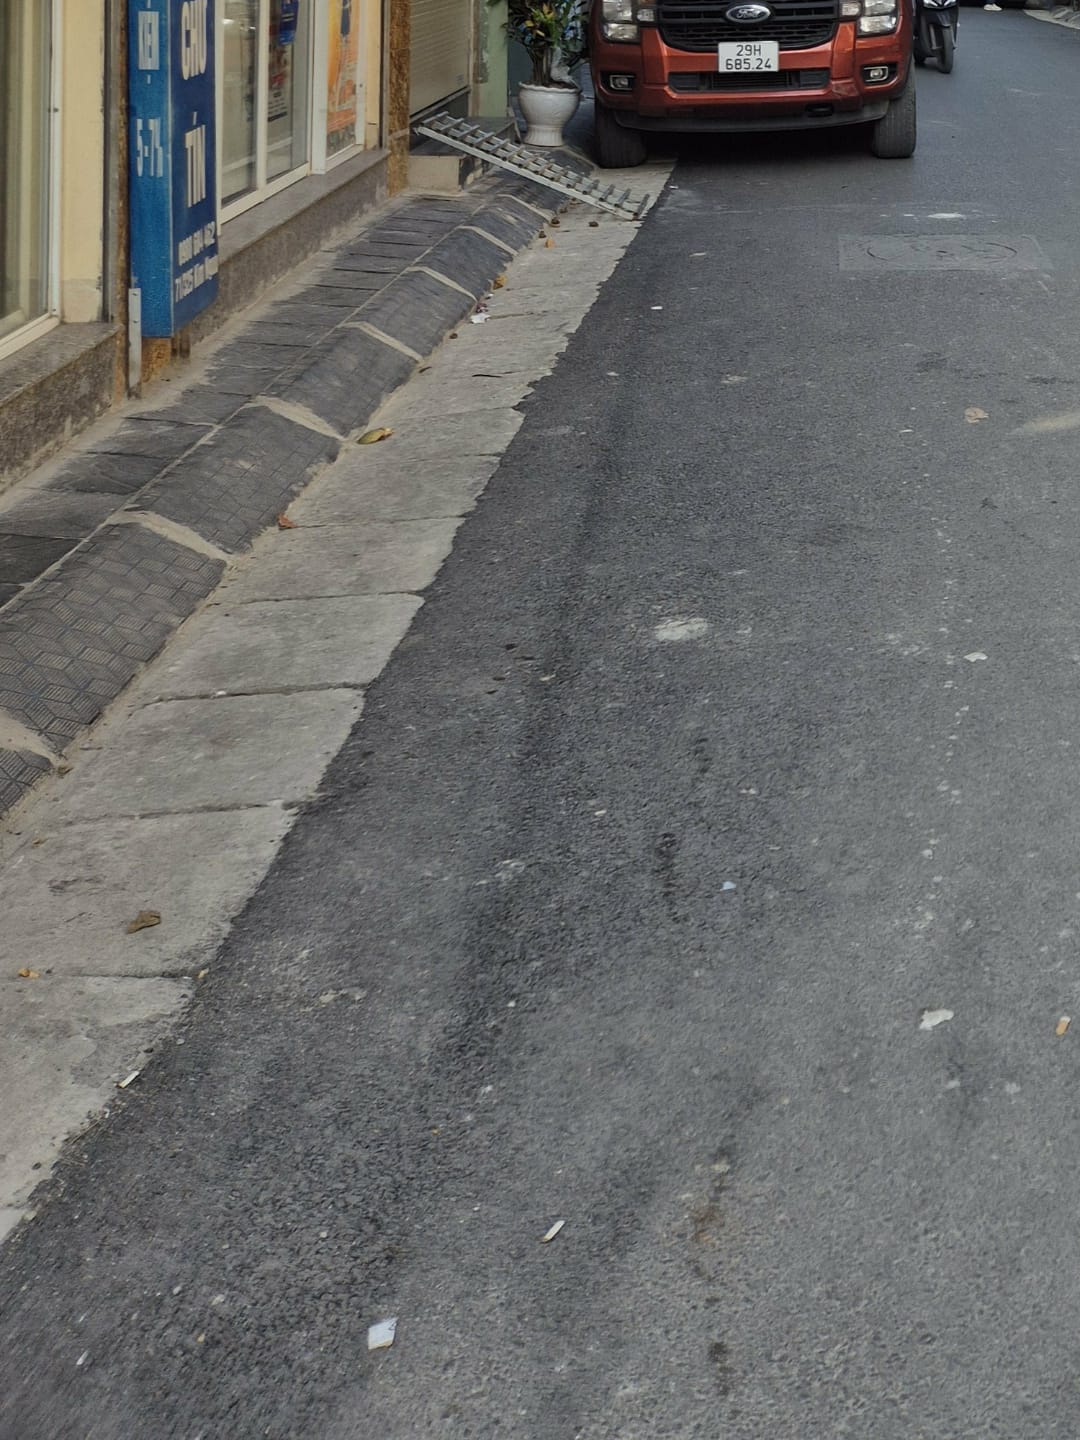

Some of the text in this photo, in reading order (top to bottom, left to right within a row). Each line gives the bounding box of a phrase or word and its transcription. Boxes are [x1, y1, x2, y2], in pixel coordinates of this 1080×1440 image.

[736, 44, 761, 56] 29H
[725, 58, 772, 70] 685.24
[185, 112, 206, 208] TÍN
